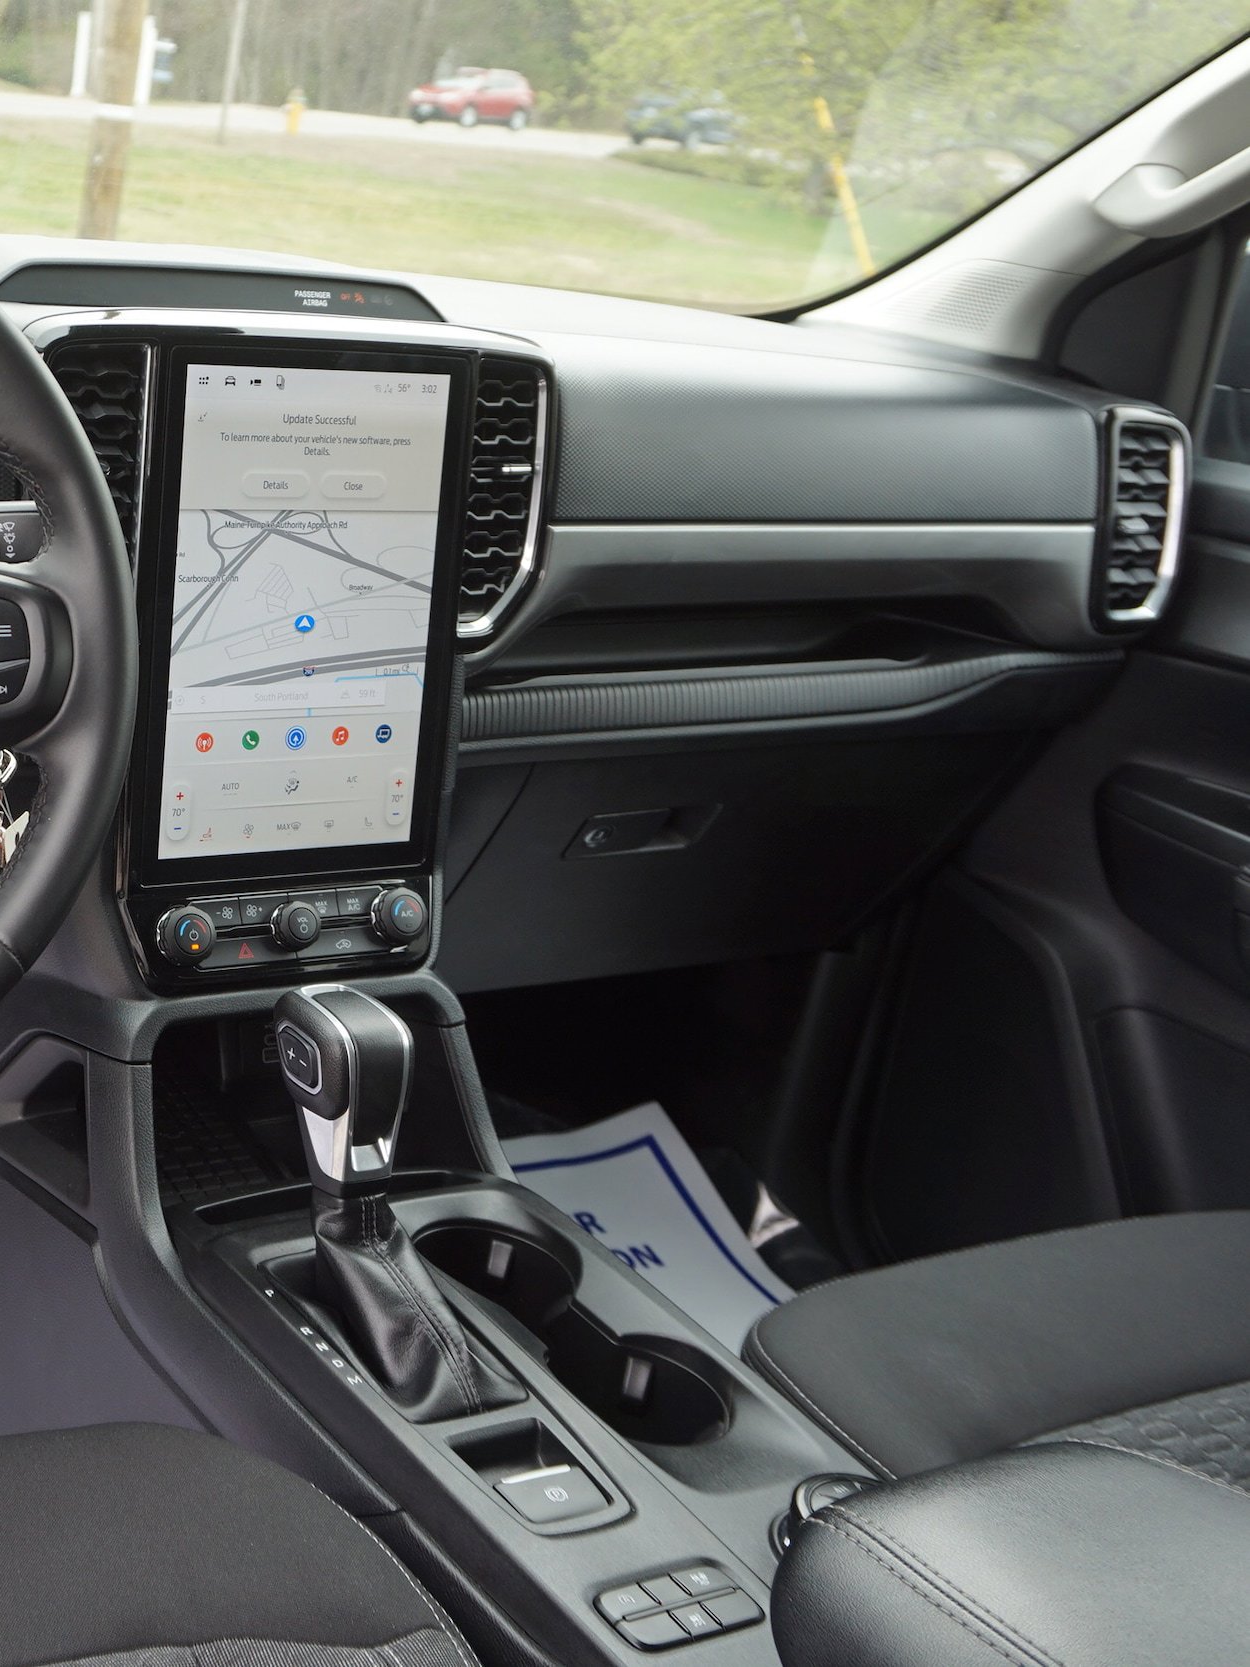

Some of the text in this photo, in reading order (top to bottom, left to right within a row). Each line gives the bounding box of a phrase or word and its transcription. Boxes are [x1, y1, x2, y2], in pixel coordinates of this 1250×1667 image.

[294, 290, 331, 299] PASSENGER
[302, 299, 328, 307] AIRBAG
[421, 384, 438, 394] 3:02
[283, 414, 357, 426] Update Successful
[220, 432, 411, 447] To learn more about your vehicle's new software, press
[304, 446, 331, 456] Details.
[263, 480, 289, 490] Details
[343, 481, 363, 491] Close
[224, 521, 244, 529] Maine
[276, 521, 306, 530] Authority
[307, 521, 338, 530] Approach
[339, 521, 348, 529] Rd
[178, 574, 220, 583] Scarborough
[349, 584, 373, 592] Broadway
[254, 691, 309, 702] South Portland
[346, 775, 358, 783] A/C
[221, 783, 240, 791] AUTO
[276, 822, 291, 831] MAX
[348, 903, 361, 911] A/C
[401, 909, 414, 918] A/C
[297, 916, 309, 924] VOL
[264, 1289, 363, 1385] P R N D M
